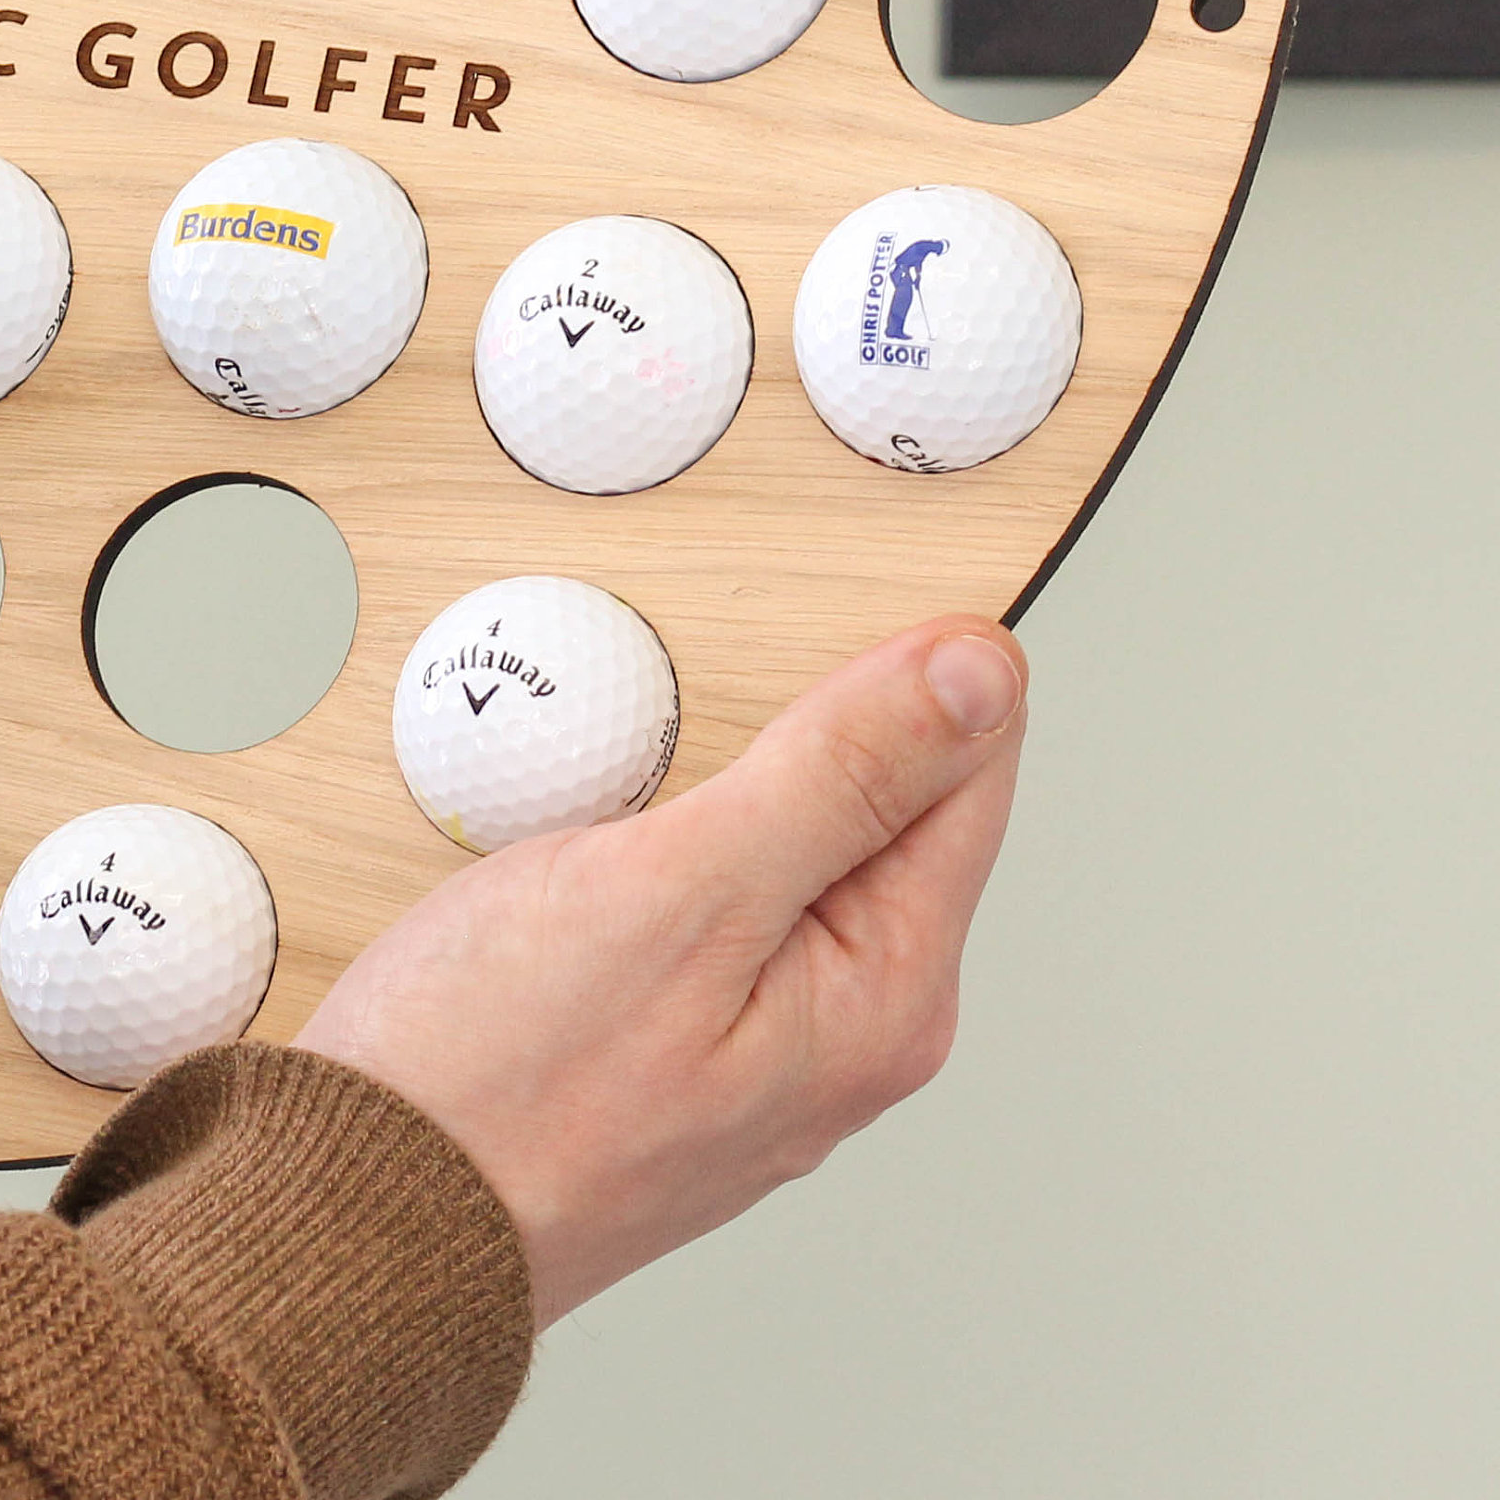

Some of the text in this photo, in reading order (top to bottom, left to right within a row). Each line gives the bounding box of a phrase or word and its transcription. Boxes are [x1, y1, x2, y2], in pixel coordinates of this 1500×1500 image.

[75, 19, 513, 134] GOLFER
[179, 208, 323, 253] Burdens
[580, 258, 600, 280] 2
[518, 282, 647, 338] Callaway
[861, 234, 895, 363] CHRIS POTTER
[486, 618, 503, 638] 4
[422, 642, 557, 701] Callaway
[99, 851, 117, 873] 4
[39, 876, 167, 935] Callaway
